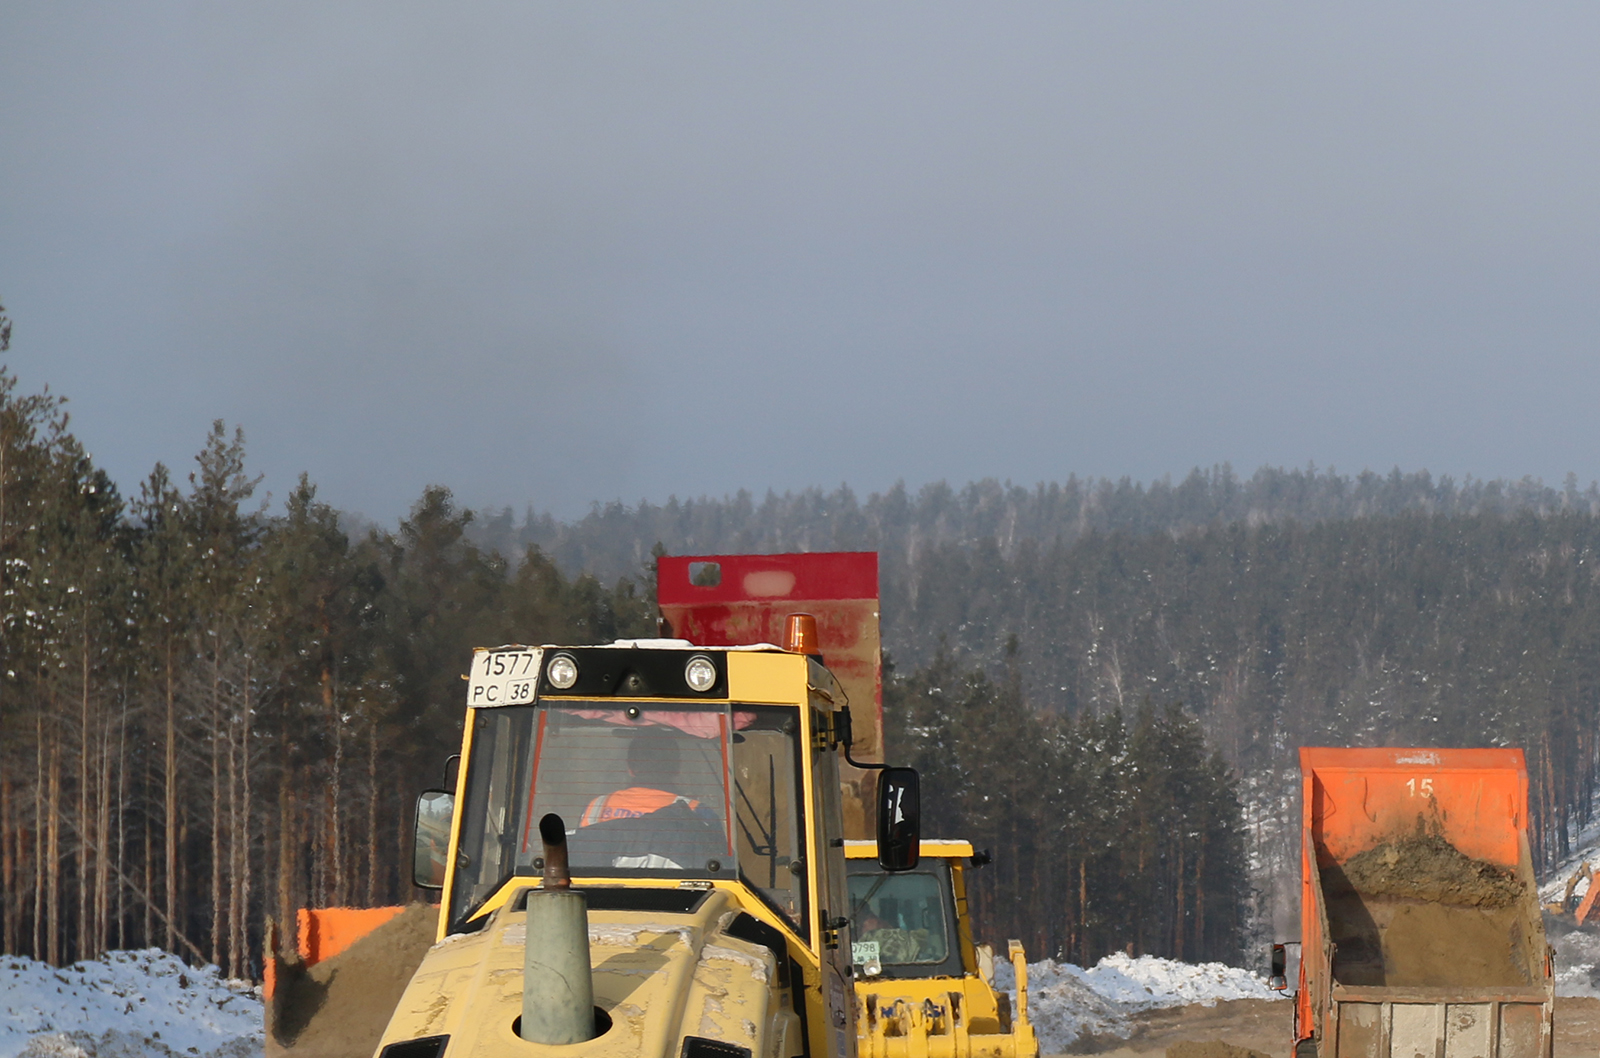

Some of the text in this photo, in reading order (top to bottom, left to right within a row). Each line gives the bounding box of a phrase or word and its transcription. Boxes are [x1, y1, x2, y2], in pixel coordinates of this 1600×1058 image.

[483, 653, 533, 676] 1577
[510, 683, 530, 700] 38
[1405, 778, 1434, 798] 15
